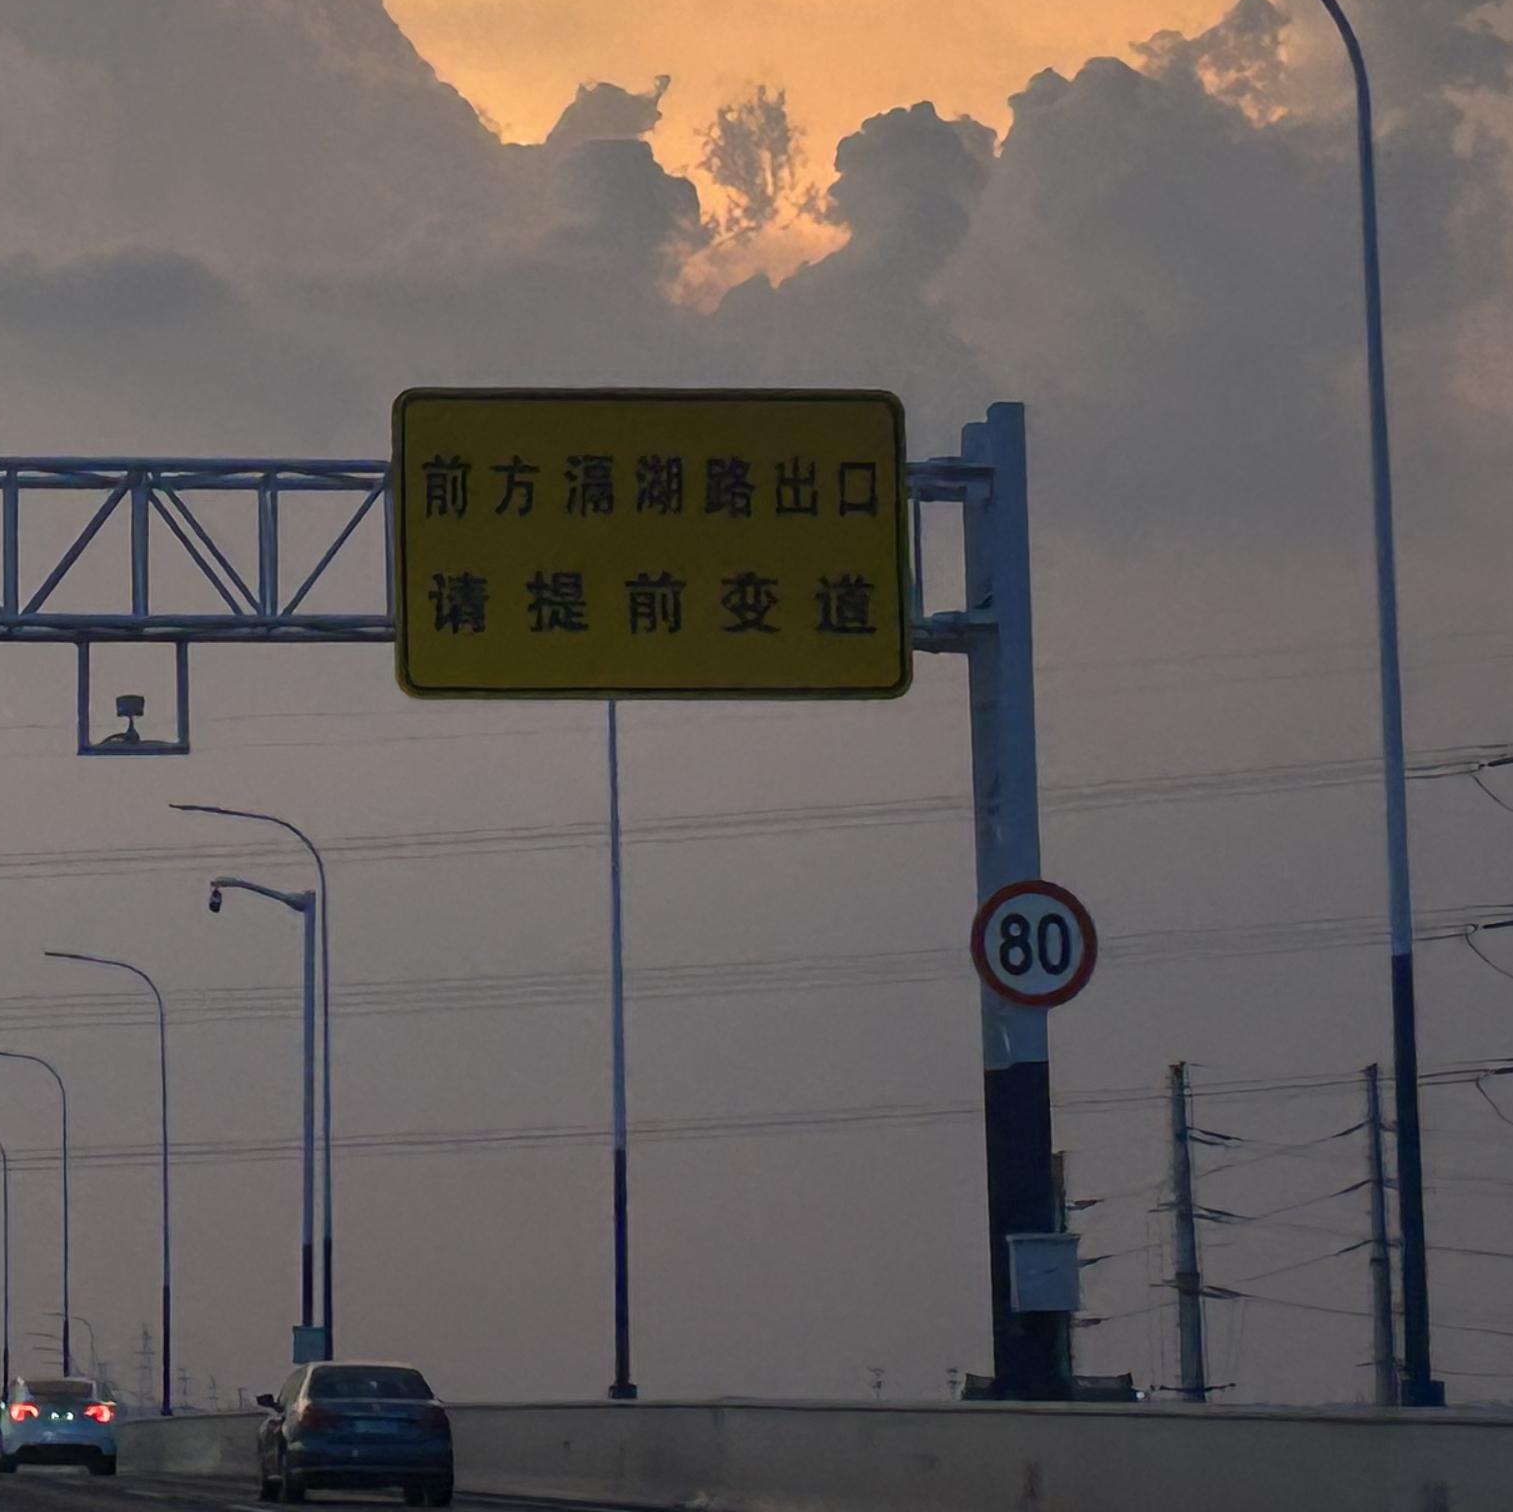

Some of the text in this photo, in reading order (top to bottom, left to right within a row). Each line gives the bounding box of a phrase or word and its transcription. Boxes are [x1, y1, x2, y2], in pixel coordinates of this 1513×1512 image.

[428, 571, 878, 634] 请提前变道
[999, 913, 1071, 976] 80
